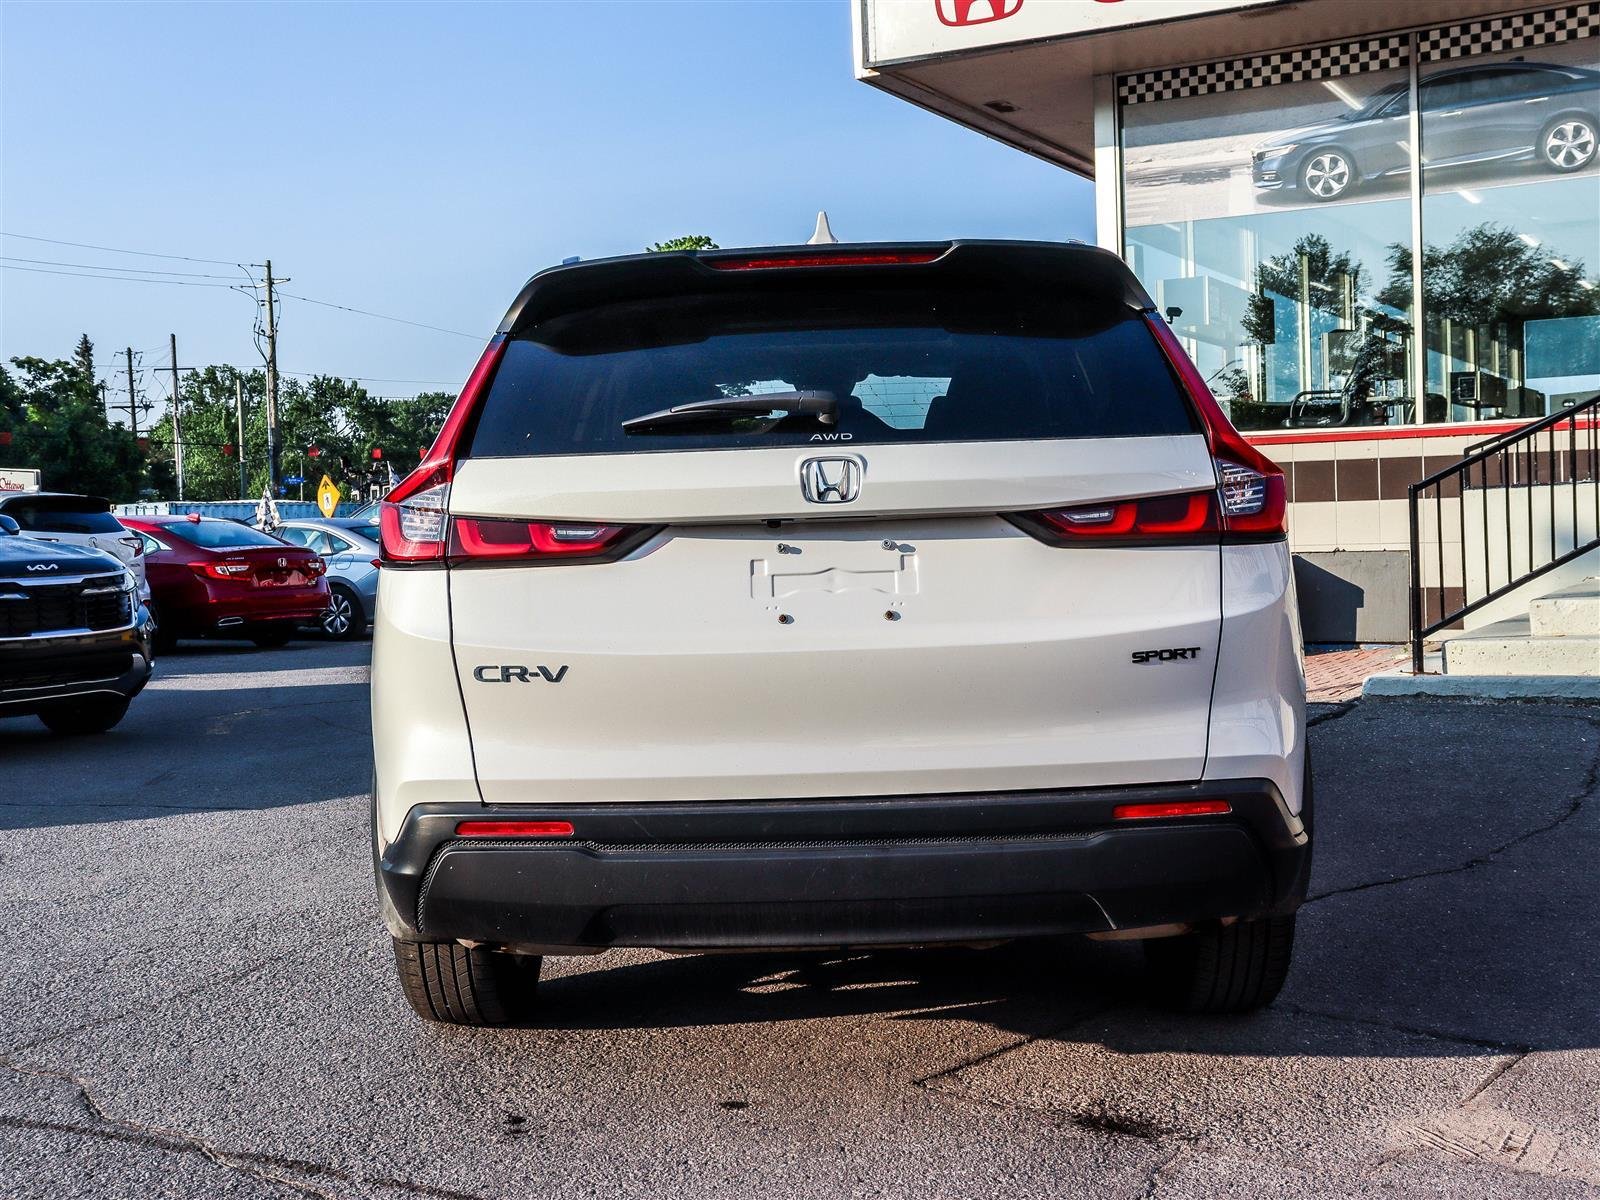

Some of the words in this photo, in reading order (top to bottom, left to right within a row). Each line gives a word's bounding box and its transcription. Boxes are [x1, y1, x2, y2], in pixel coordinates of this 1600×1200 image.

[809, 432, 853, 441] AWD
[1131, 646, 1201, 664] SPORT
[473, 665, 569, 683] CR-V
